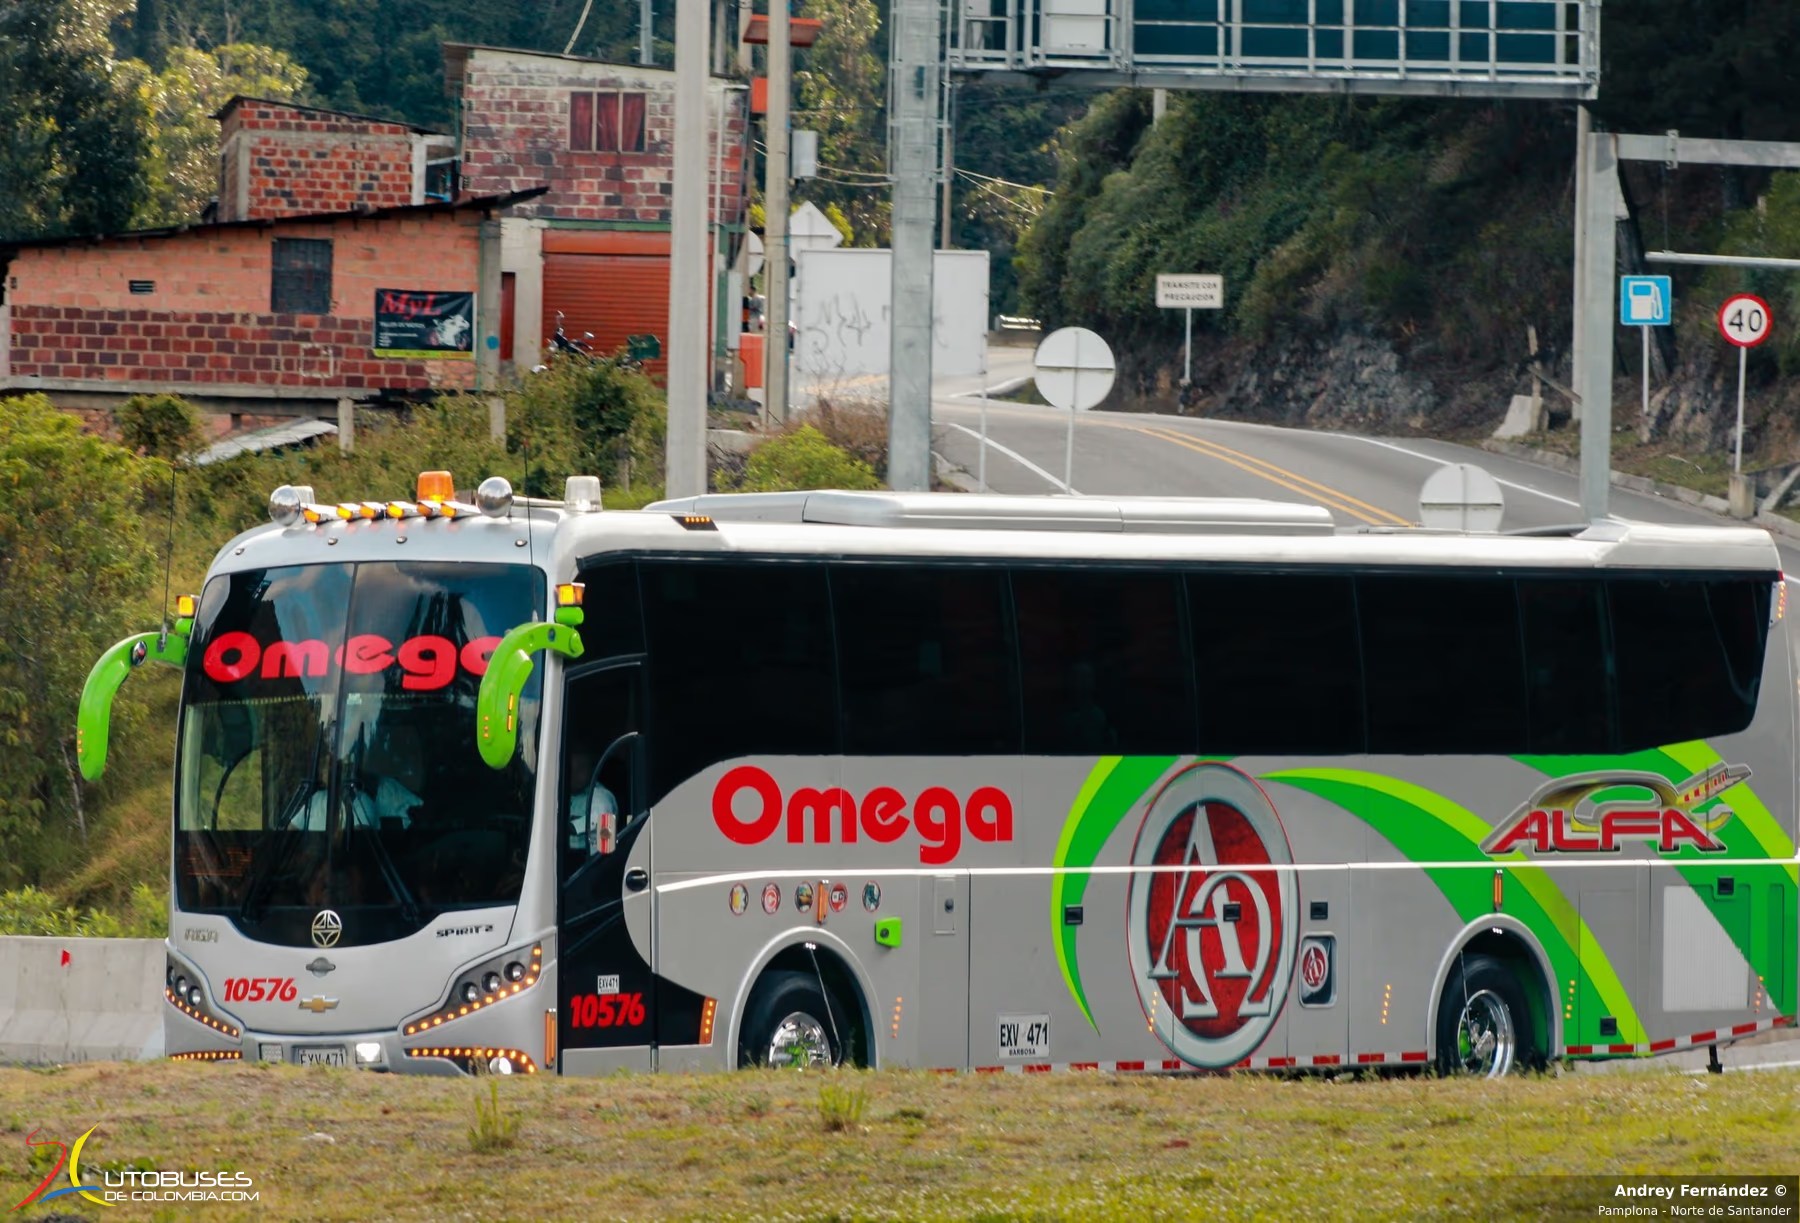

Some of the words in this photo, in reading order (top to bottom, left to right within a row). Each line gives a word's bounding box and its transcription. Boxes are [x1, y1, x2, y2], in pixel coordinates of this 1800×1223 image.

[1728, 308, 1762, 332] 40
[712, 765, 1014, 865] Omega
[1488, 808, 1725, 854] ALFA
[436, 925, 483, 938] SPIRIT
[224, 977, 298, 1003] 10576
[570, 992, 646, 1028] 10576
[1000, 1023, 1019, 1047] EXV
[1027, 1022, 1048, 1046] 471
